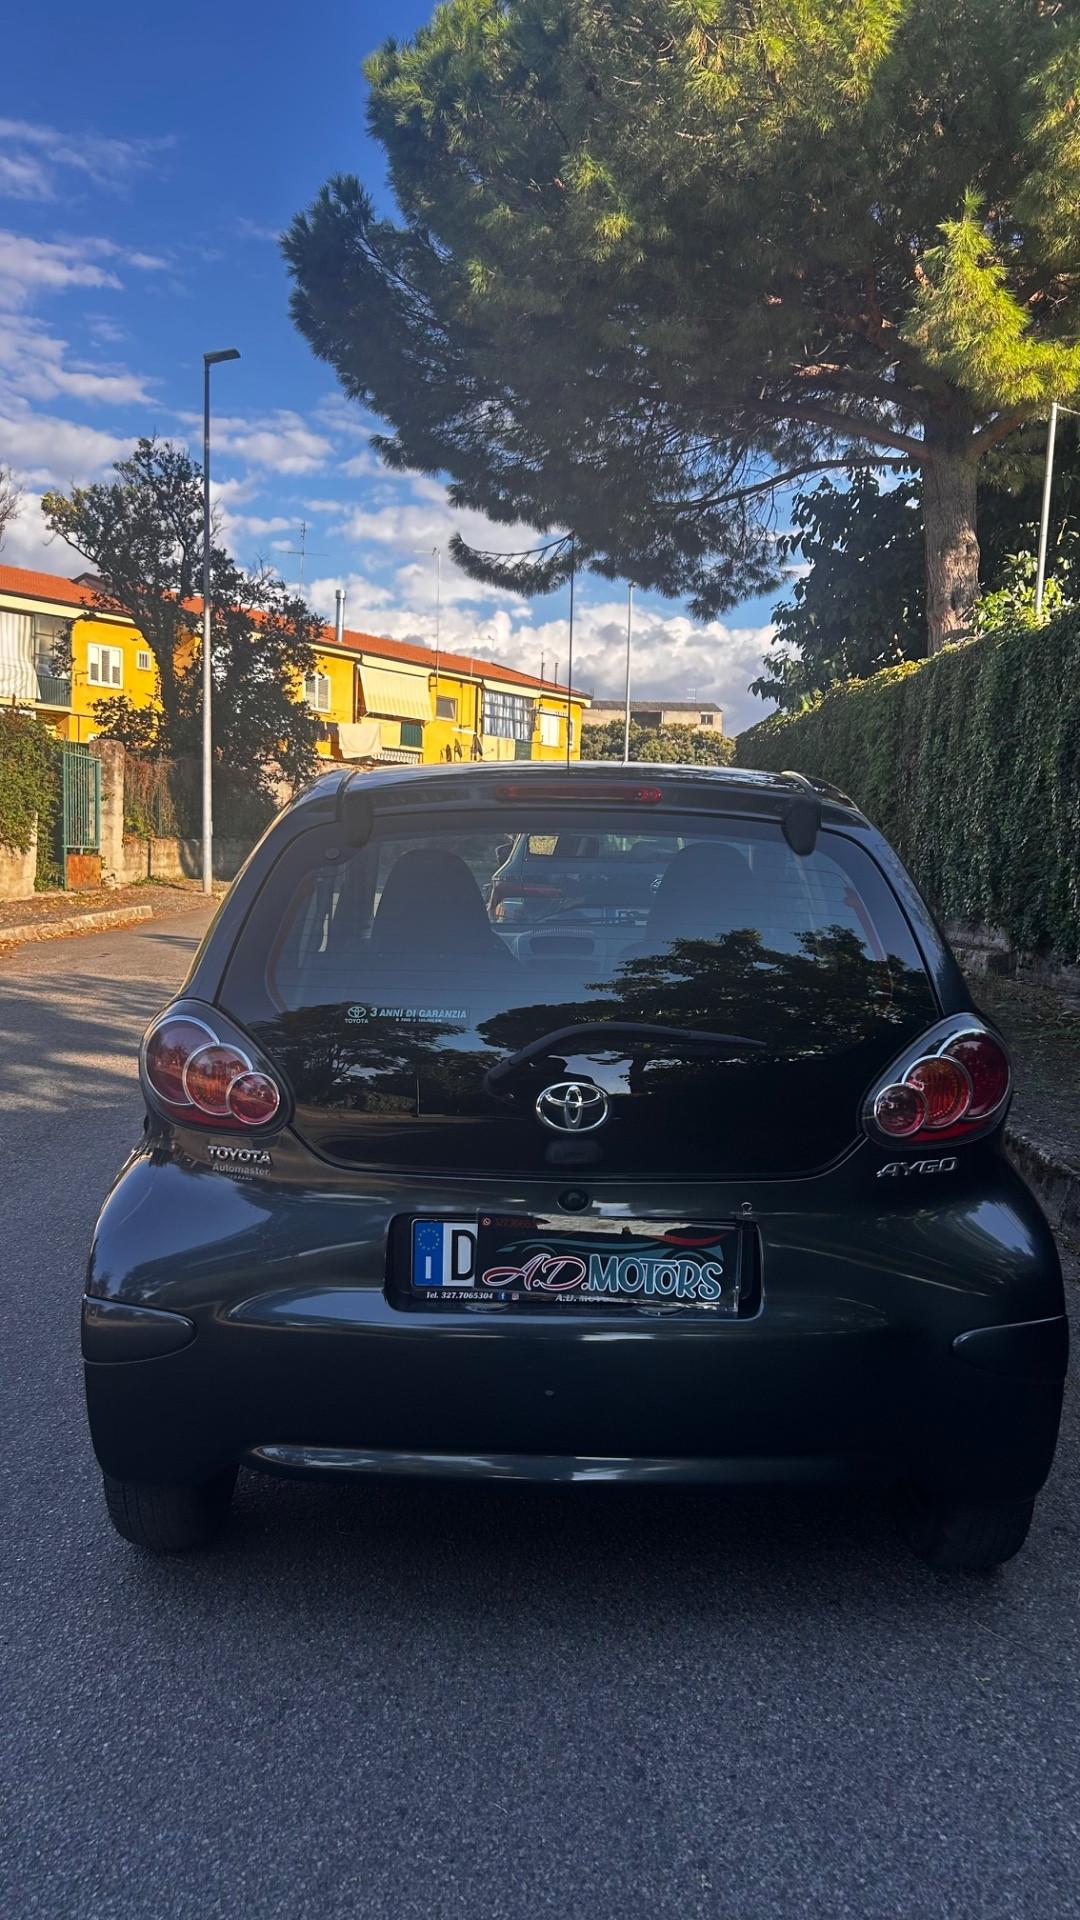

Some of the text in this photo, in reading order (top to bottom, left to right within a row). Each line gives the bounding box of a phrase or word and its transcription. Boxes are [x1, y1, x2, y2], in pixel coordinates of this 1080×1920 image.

[370, 1007, 467, 1018] 3 ANNI DI GARANZIA
[207, 1145, 271, 1164] TOYOTA
[876, 1157, 957, 1177] AYGO
[426, 1291, 494, 1299] Tel. 327.7065304
